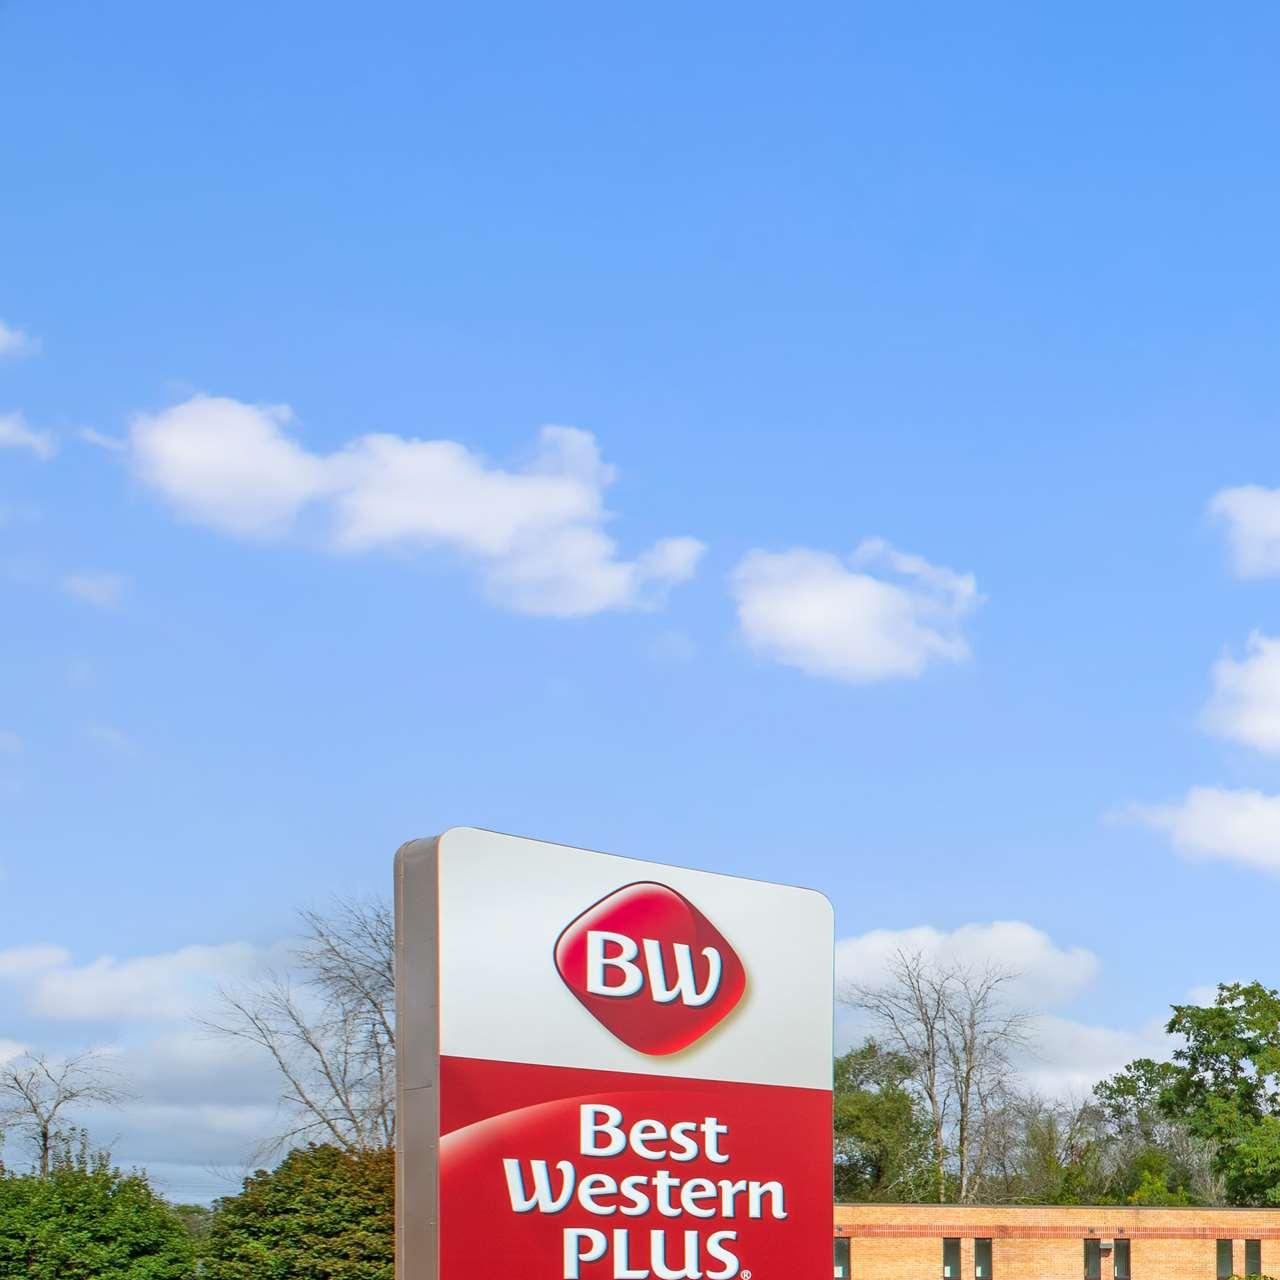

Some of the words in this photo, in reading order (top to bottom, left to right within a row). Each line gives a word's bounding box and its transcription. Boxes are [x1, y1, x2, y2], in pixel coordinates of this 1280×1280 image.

[585, 929, 722, 1008] BW
[579, 1103, 729, 1164] Best
[502, 1157, 787, 1220] Western
